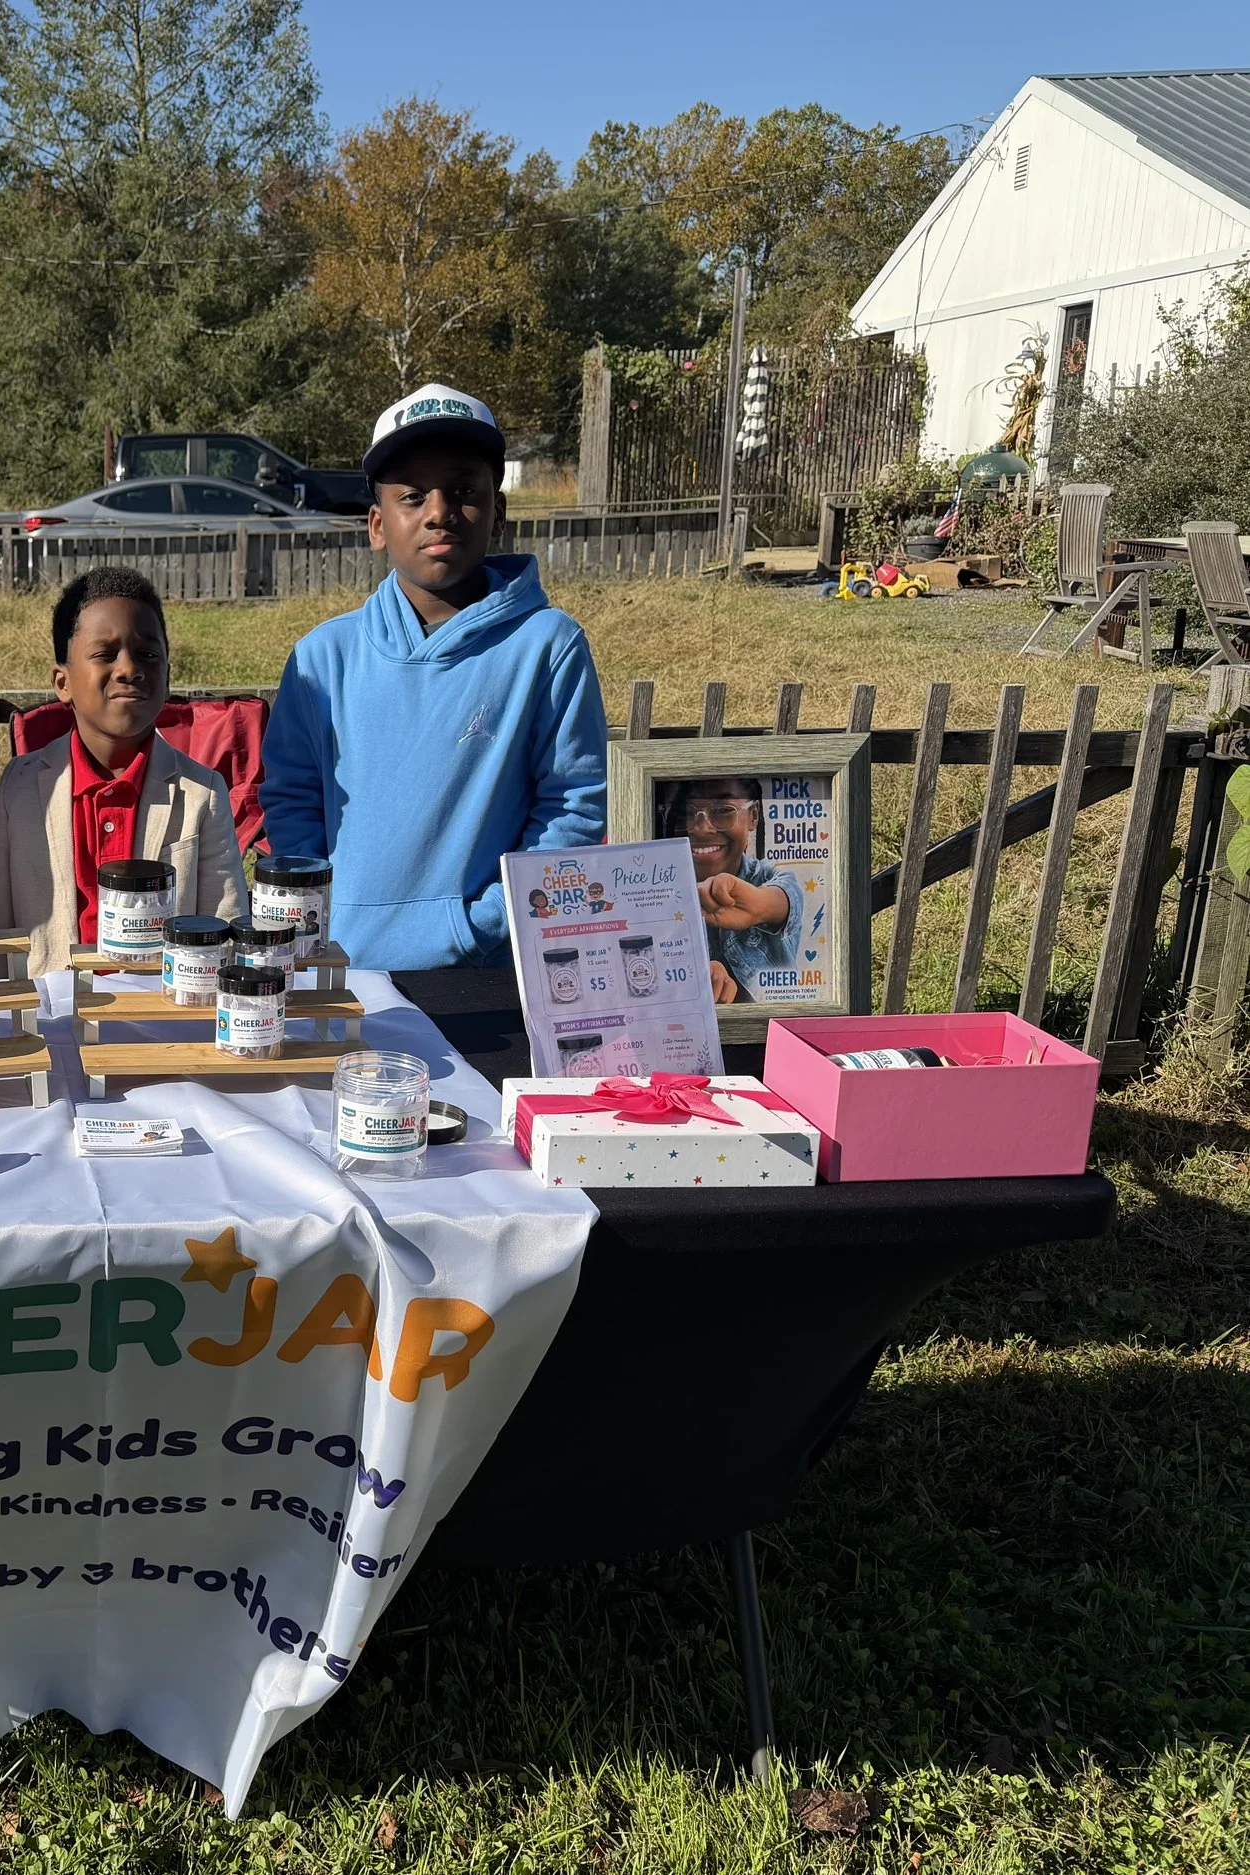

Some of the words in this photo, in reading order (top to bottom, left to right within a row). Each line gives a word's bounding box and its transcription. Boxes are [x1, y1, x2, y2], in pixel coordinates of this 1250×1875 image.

[772, 777, 810, 799] Pick
[769, 804, 778, 819] a
[784, 800, 827, 818] note.
[774, 822, 816, 844] Build
[767, 844, 828, 860] confidence
[543, 874, 588, 890] CHEER
[612, 867, 648, 888] Price
[652, 864, 676, 886] List
[552, 888, 585, 906] JAR
[550, 927, 578, 936] EVERYDAY
[579, 923, 619, 932] AFFIRMATIONS
[665, 968, 686, 982] $10
[590, 977, 606, 990] $5
[234, 1018, 274, 1028] CHEERJAR
[561, 1021, 580, 1030] MOM'S
[582, 1017, 620, 1028] AFFIRMATIONS
[613, 1044, 622, 1052] 30
[622, 1040, 644, 1050] CARDS
[617, 1063, 638, 1076] $10
[365, 1117, 416, 1128] CHEERJAR
[46, 1418, 197, 1466] Kids
[221, 1416, 406, 1509] Grow
[0, 1493, 207, 1518] Kindness
[251, 1488, 411, 1579] Resilien
[80, 1561, 114, 1585] 3
[131, 1557, 352, 1683] brothers
